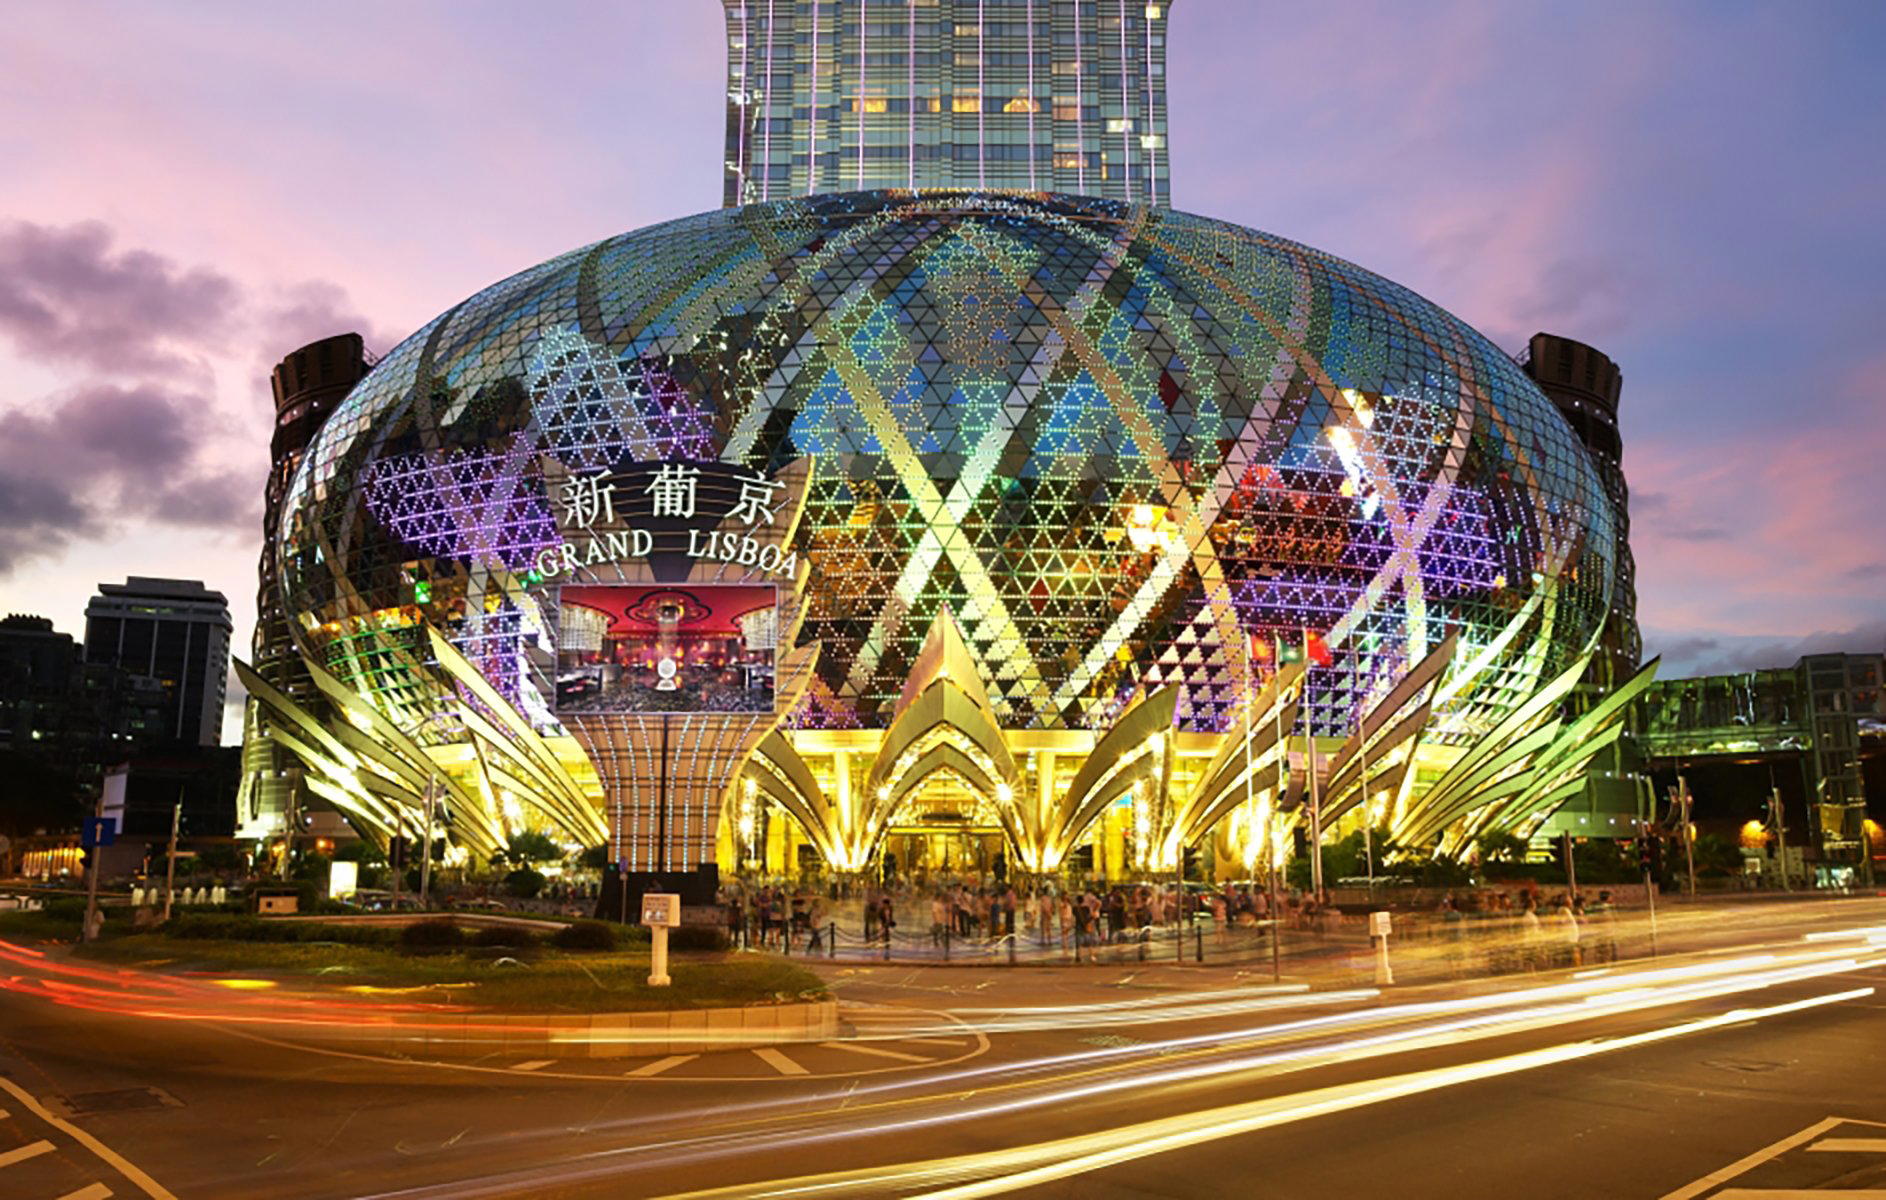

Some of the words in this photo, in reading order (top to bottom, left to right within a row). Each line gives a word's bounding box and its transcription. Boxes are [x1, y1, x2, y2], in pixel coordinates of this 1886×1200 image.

[559, 464, 786, 529] 新葡京
[537, 529, 653, 577] GRAND
[687, 529, 798, 580] LISBOA
